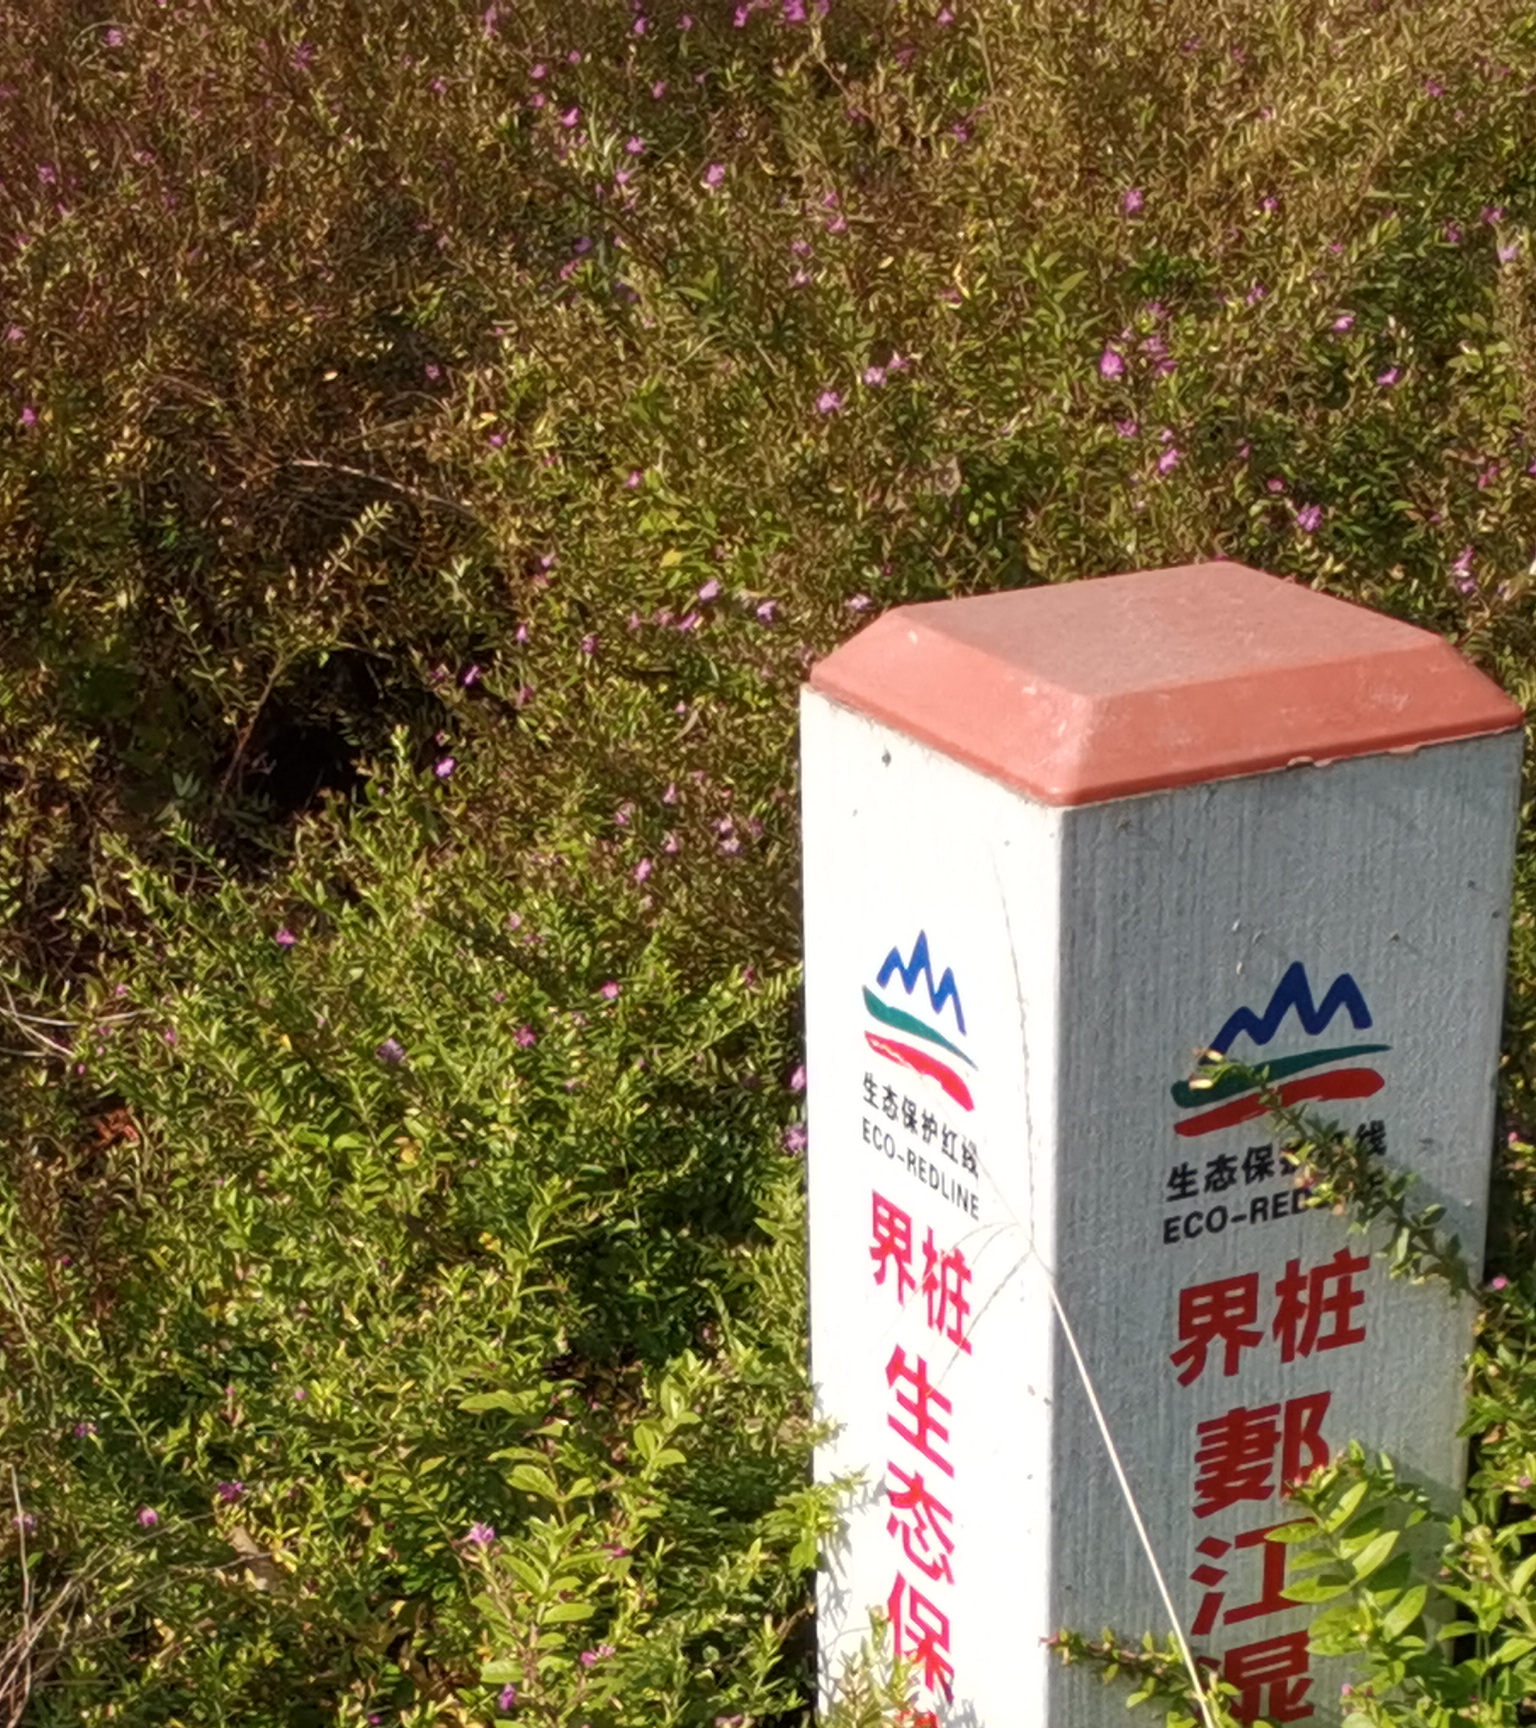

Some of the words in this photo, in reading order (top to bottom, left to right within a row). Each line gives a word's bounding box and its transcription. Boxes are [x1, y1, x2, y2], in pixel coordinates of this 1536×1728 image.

[863, 1071, 979, 1181] 生态保护红线
[863, 1116, 980, 1221] ECO-REDLINE
[1166, 1118, 1387, 1202] 生态保线
[1163, 1170, 1384, 1245] ECO-RED
[869, 1188, 973, 1356] 界桩
[1170, 1247, 1370, 1387] 界桩
